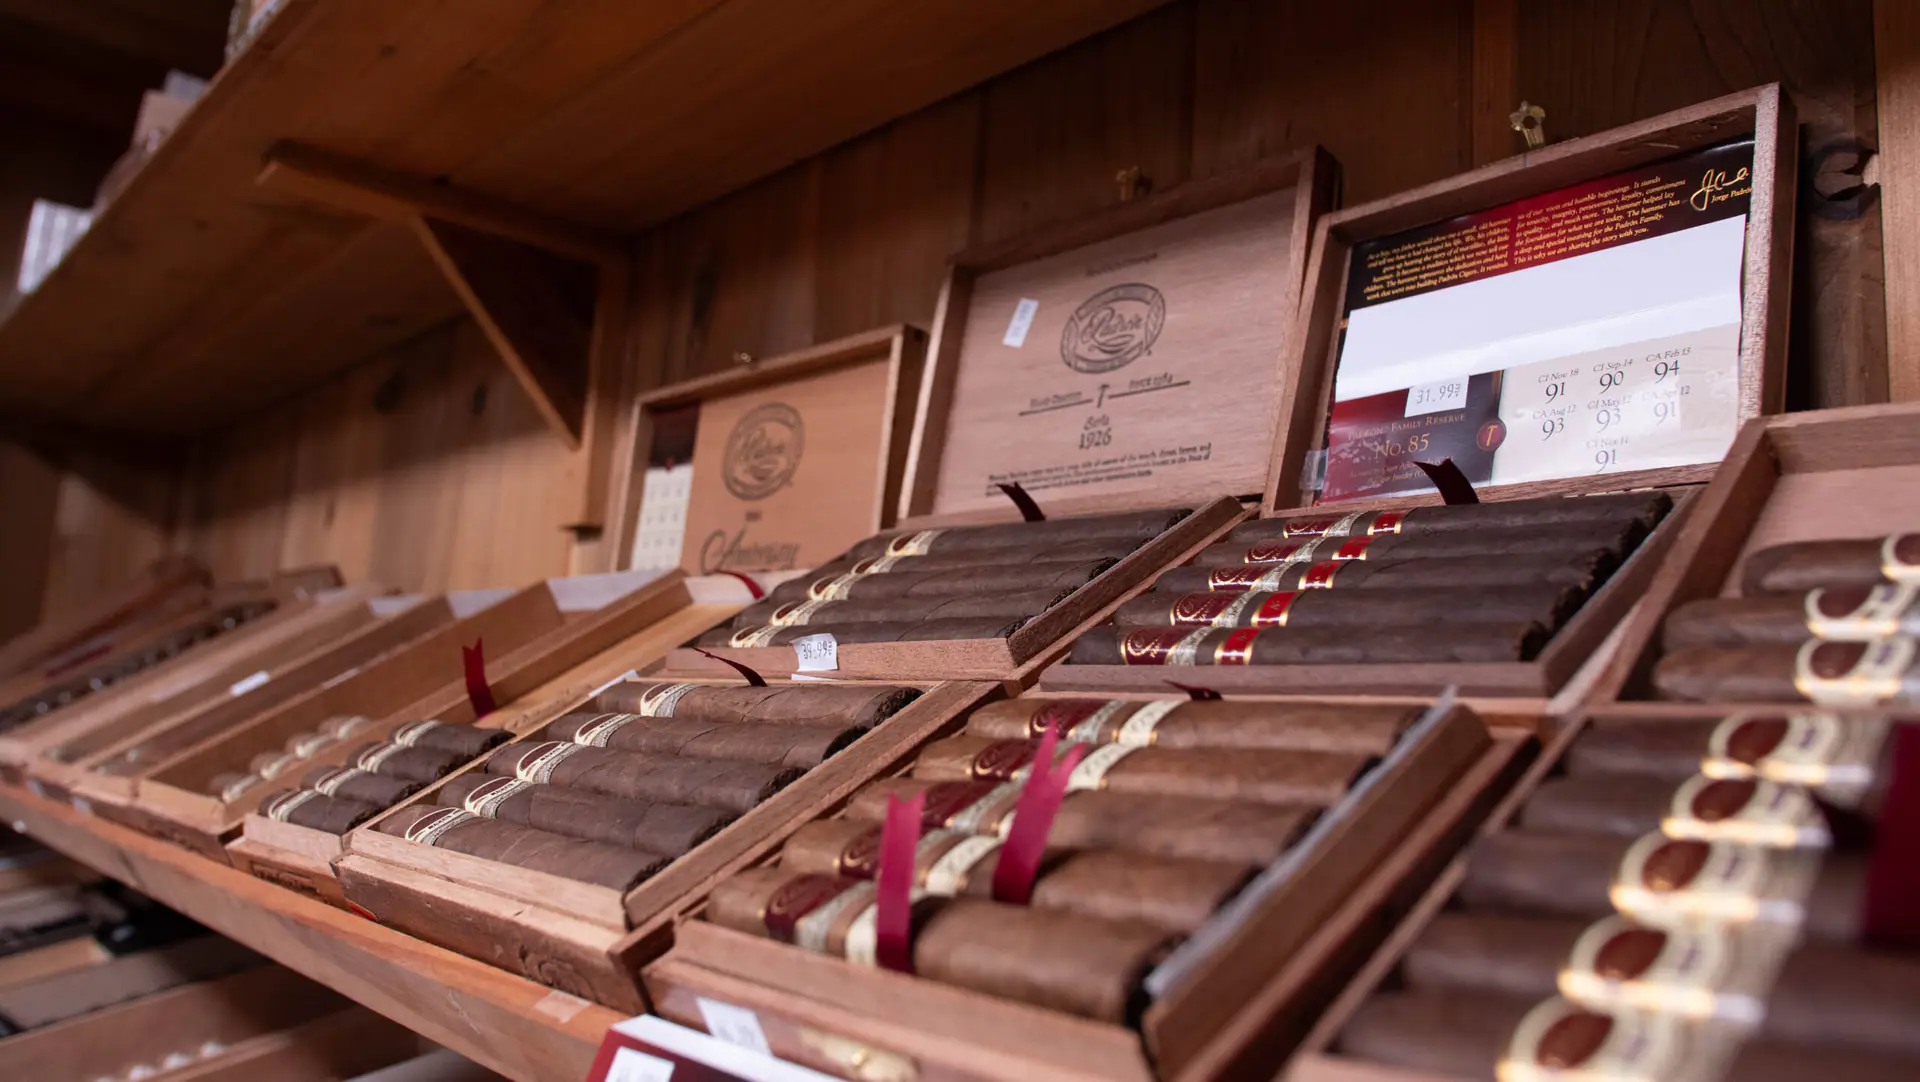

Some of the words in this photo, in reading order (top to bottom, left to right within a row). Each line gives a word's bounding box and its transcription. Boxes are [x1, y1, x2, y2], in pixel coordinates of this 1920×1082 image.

[1730, 185, 1753, 197] Padró
[1601, 206, 1614, 215] The
[1627, 208, 1640, 217] The
[1641, 202, 1667, 213] hammer
[1668, 198, 1680, 206] has
[1593, 228, 1603, 237] for
[1604, 225, 1614, 233] the
[1514, 256, 1526, 264] This
[1591, 237, 1600, 245] the
[1601, 233, 1618, 242] story
[1619, 228, 1633, 238] with
[1606, 362, 1621, 371] Sep
[1623, 358, 1634, 367] 14
[1646, 354, 1661, 362] CA
[1664, 349, 1680, 360] Feb
[1550, 371, 1567, 381] Nov
[1569, 368, 1580, 377] 18
[1654, 359, 1680, 384] 94
[1599, 370, 1624, 394] 90
[1545, 381, 1565, 404] 91
[1532, 410, 1547, 419] CA
[1549, 407, 1566, 416] Aug
[1567, 404, 1577, 413] 12
[1596, 408, 1621, 433] 93
[1653, 401, 1676, 426] 91
[1391, 419, 1422, 432] FAMILY
[1426, 413, 1466, 427] RESERVE
[1542, 417, 1564, 441] 93
[1078, 427, 1112, 449] 1926
[1595, 448, 1617, 472] 91
